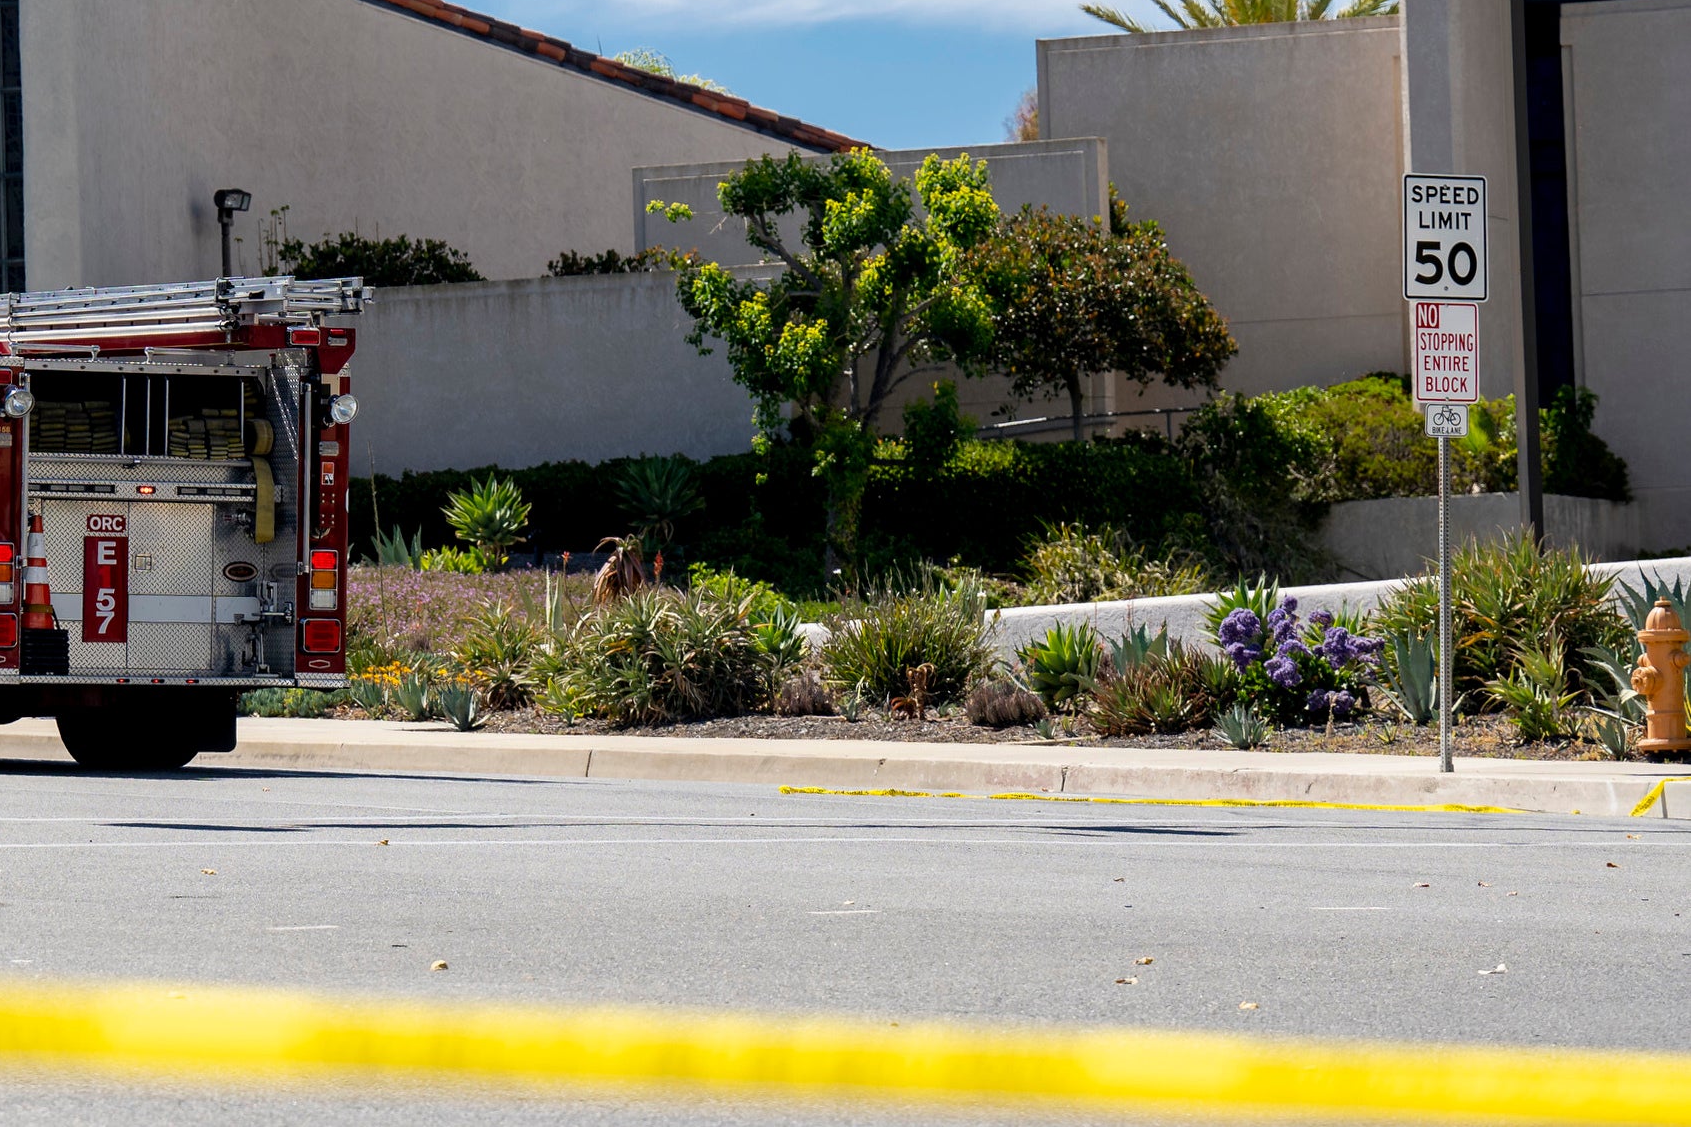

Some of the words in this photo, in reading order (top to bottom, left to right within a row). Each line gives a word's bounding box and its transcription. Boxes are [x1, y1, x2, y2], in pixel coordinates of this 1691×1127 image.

[1411, 185, 1479, 205] SPEED
[1419, 211, 1472, 230] LIMIT
[1414, 240, 1477, 286] 50
[1417, 304, 1438, 327] NO
[1420, 332, 1474, 352] STOPPING
[1424, 355, 1470, 372] ENTIRE
[1425, 376, 1468, 393] BLOCK
[1431, 426, 1445, 434] BIKE
[1445, 426, 1462, 435] LANE
[89, 516, 123, 531] ORC
